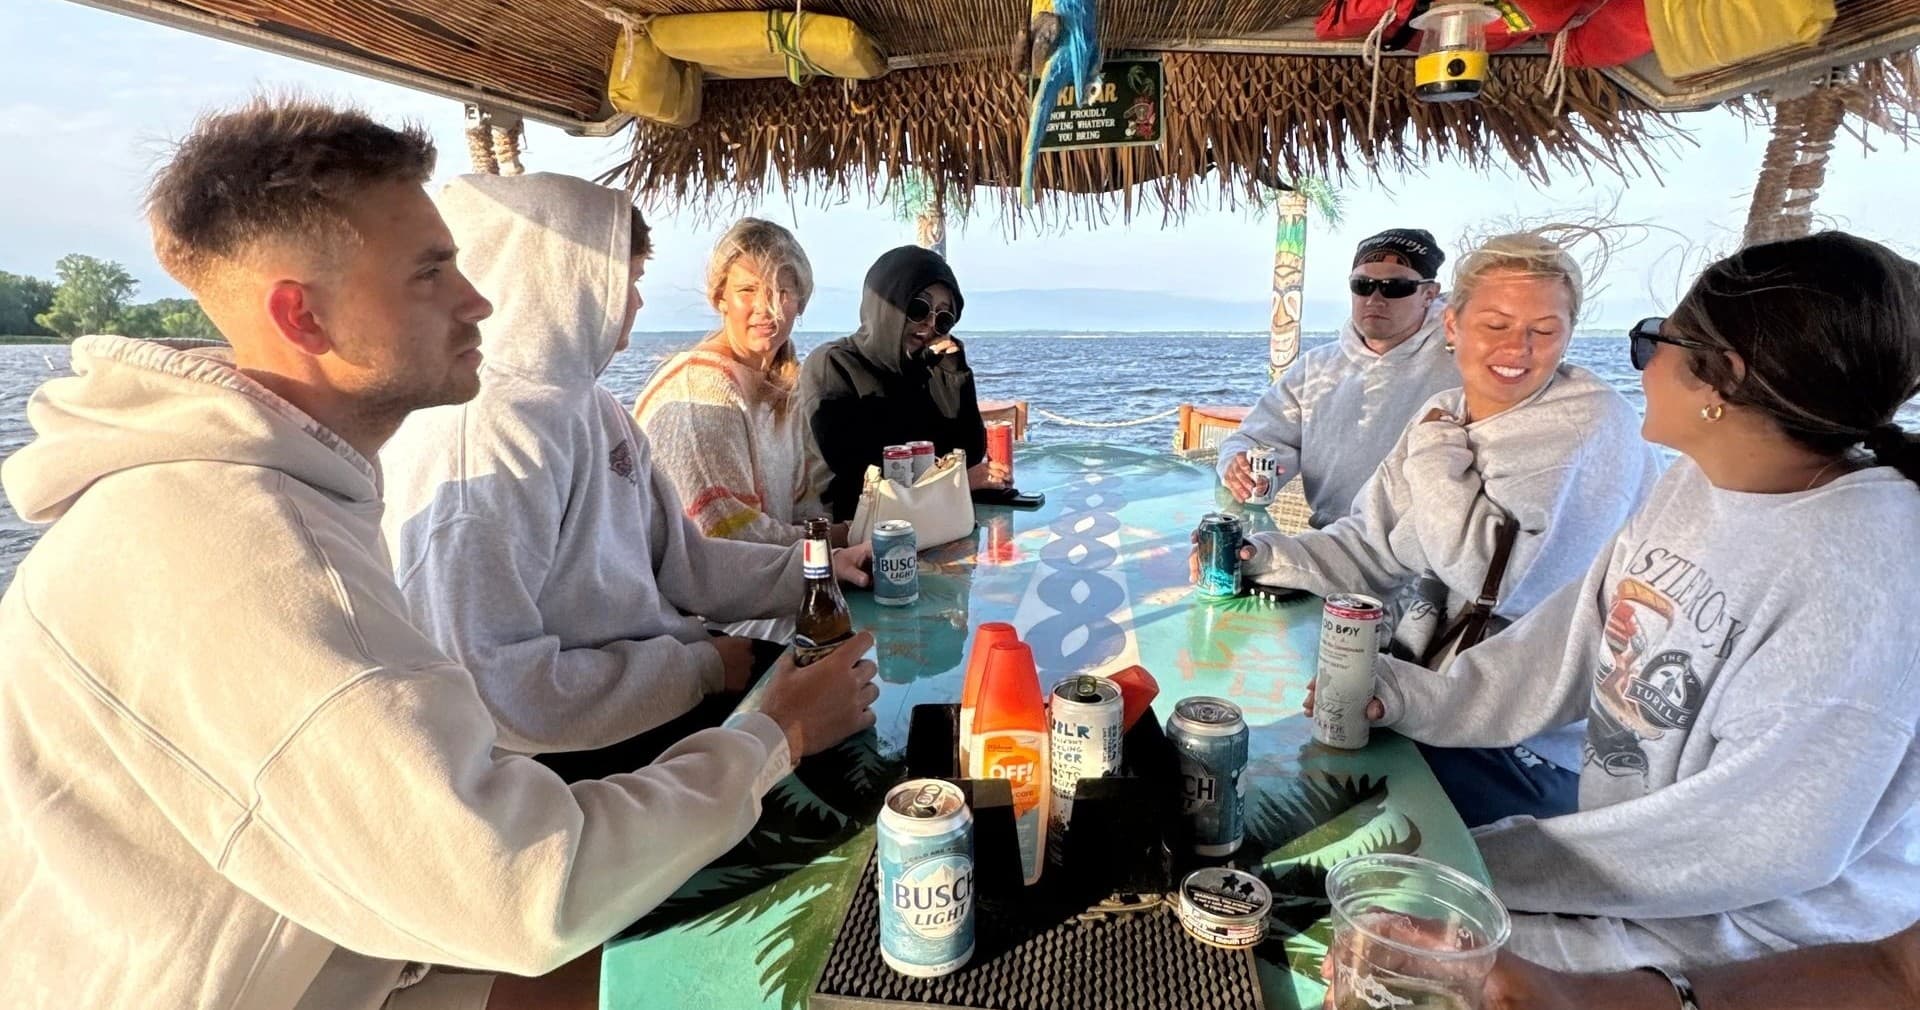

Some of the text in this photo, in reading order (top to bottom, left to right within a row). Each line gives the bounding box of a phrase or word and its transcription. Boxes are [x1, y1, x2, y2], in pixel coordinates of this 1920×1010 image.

[1050, 108, 1107, 120] NOW PROUDLY
[1046, 119, 1115, 131] ERVING WHATEVER
[1058, 131, 1100, 142] YOU BRING
[881, 556, 916, 572] BUSC
[1335, 624, 1361, 637] BOY
[1634, 685, 1689, 725] TURTLE
[989, 761, 1034, 783] OFF!
[914, 902, 967, 926] LIGHT
